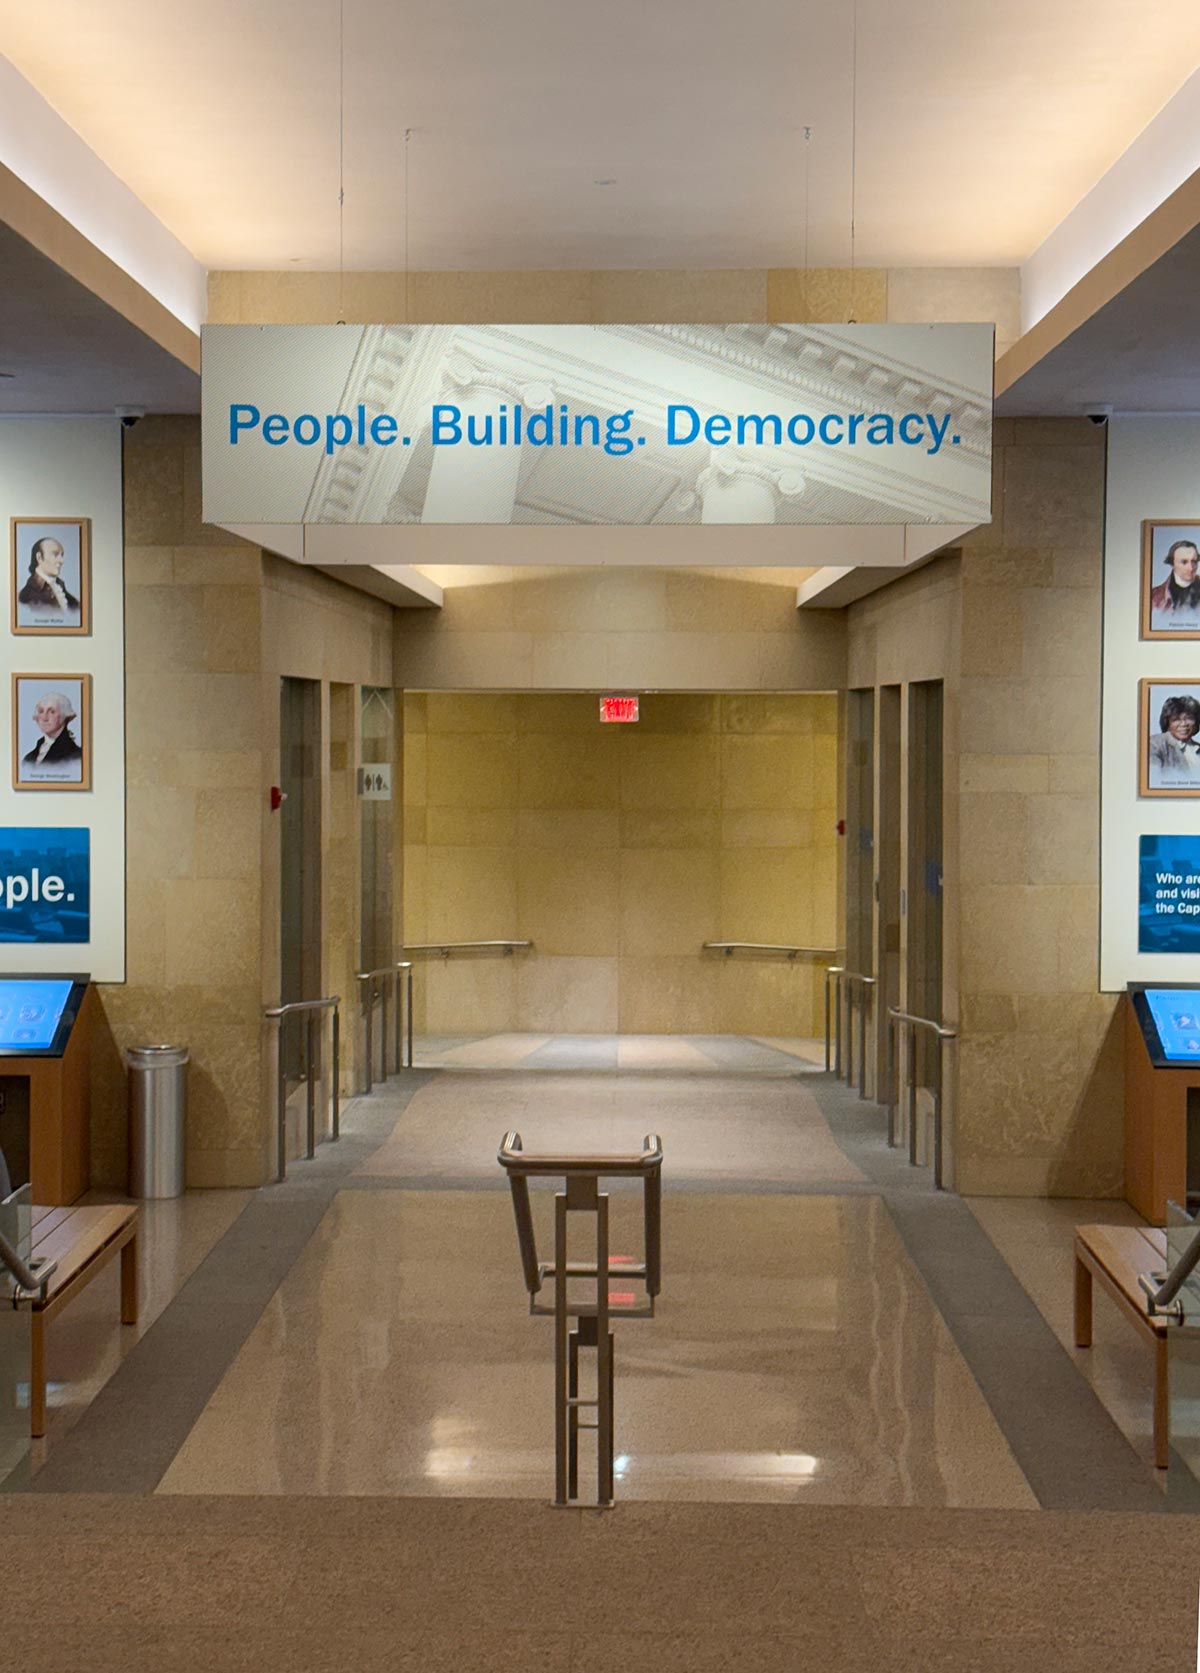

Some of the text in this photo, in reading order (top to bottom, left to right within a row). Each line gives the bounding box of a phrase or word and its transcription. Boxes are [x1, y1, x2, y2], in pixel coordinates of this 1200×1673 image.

[230, 404, 959, 456] People. Building. Democracy.
[1156, 873, 1183, 884] Who
[0, 868, 75, 909] ple.
[1156, 887, 1178, 899] and
[1156, 902, 1175, 914] the
